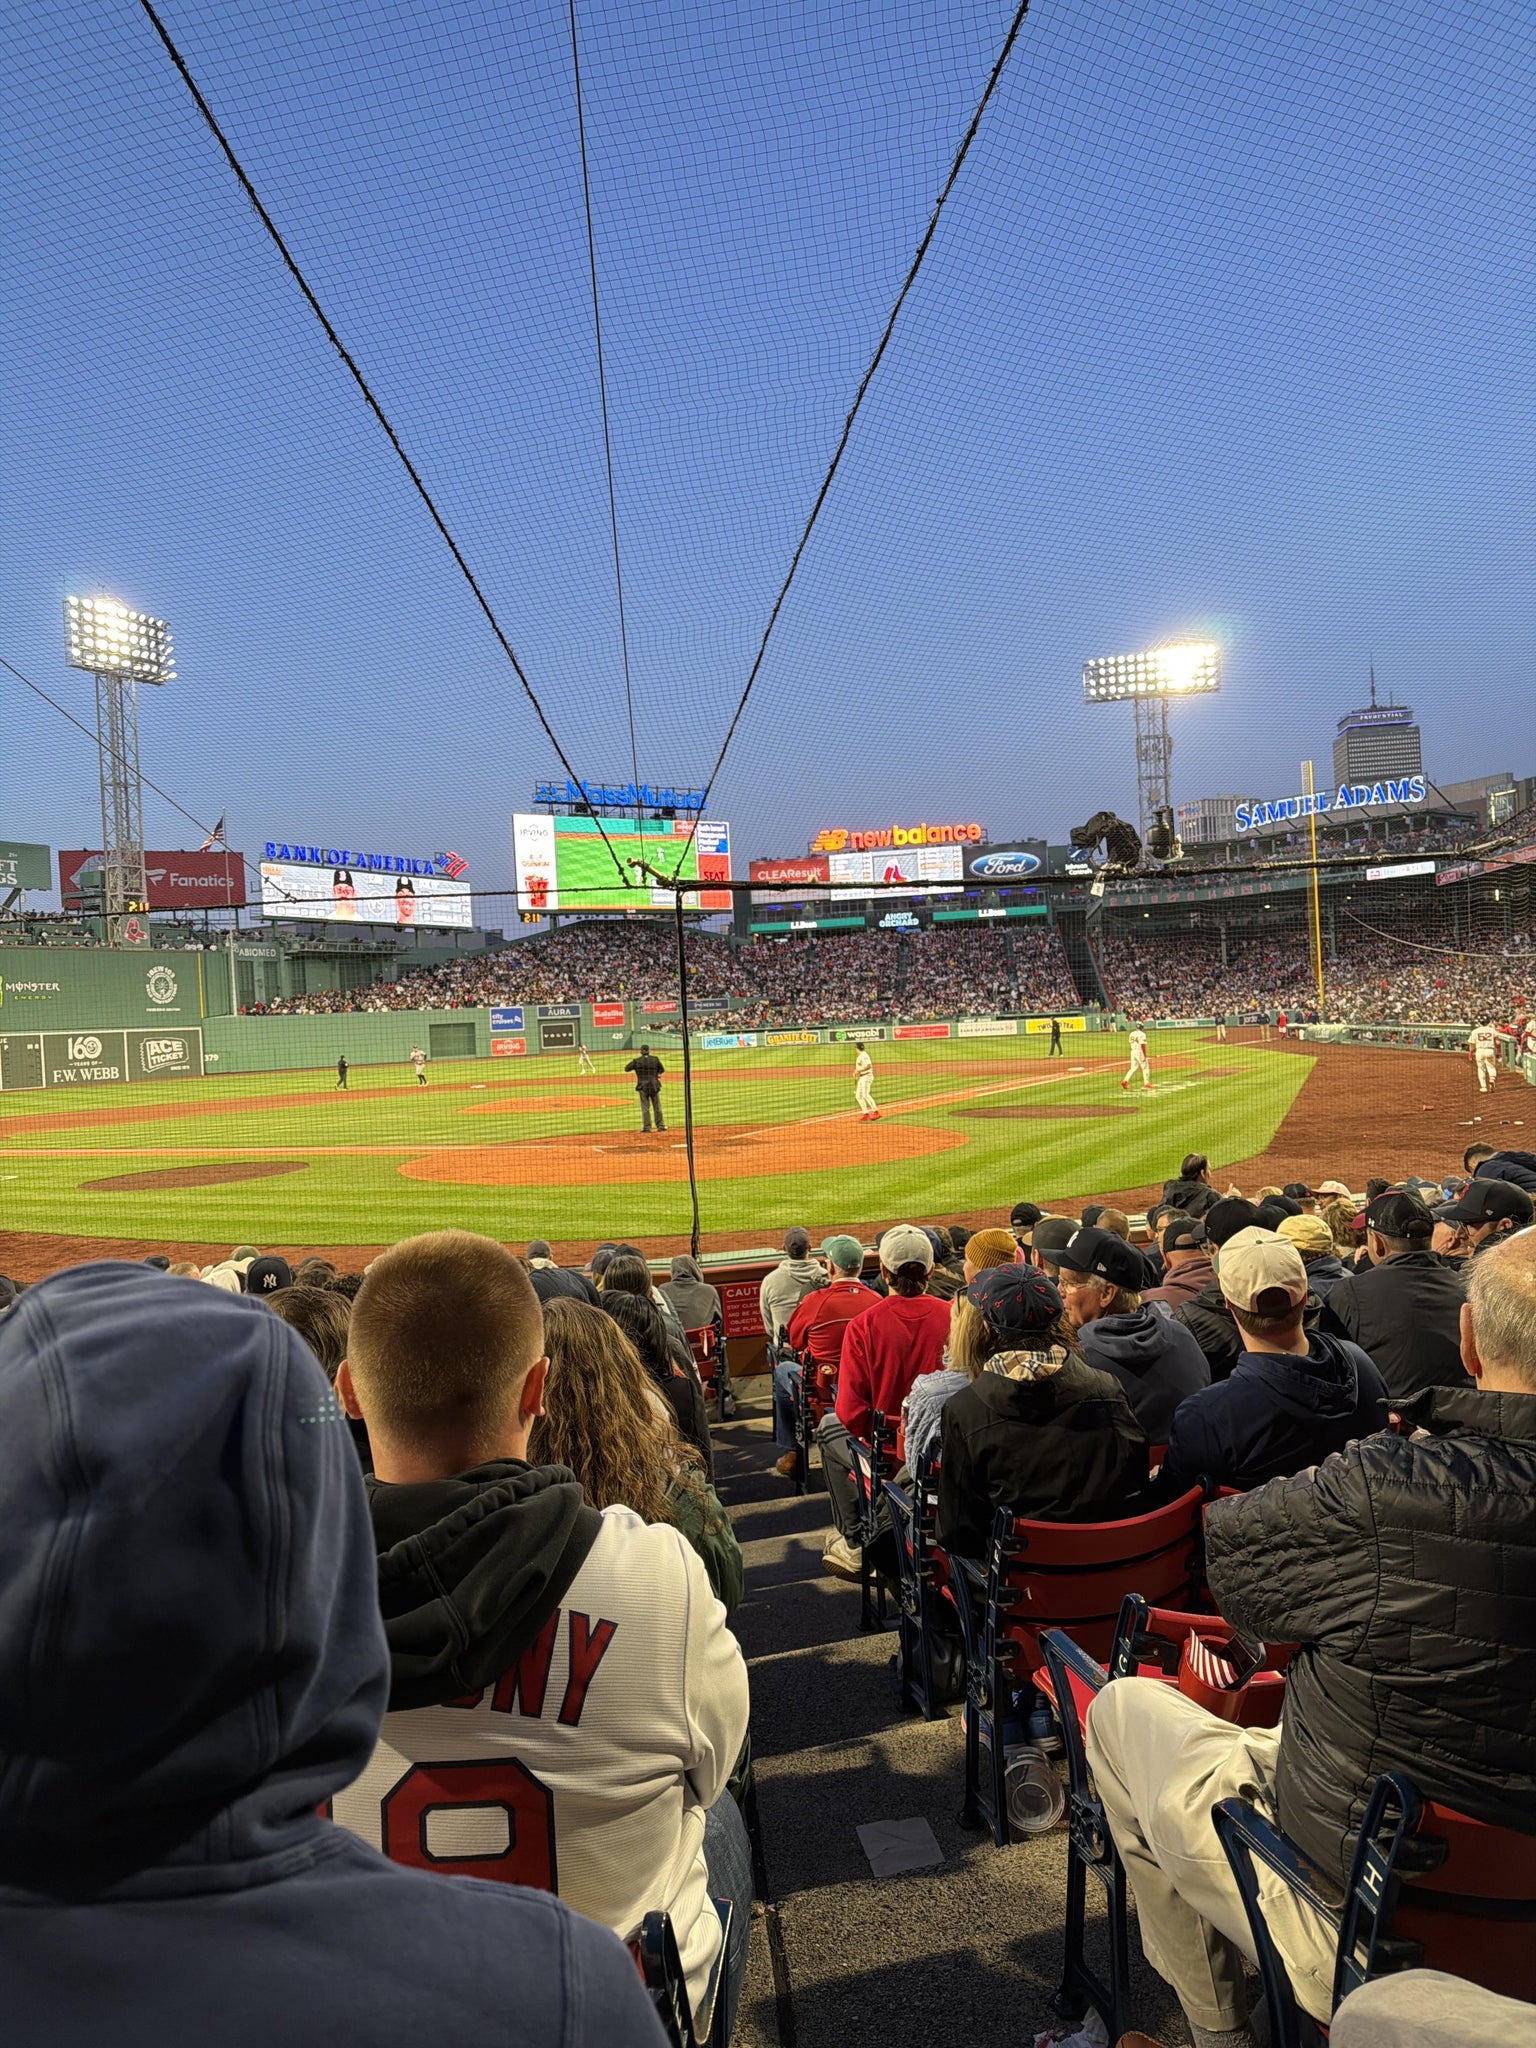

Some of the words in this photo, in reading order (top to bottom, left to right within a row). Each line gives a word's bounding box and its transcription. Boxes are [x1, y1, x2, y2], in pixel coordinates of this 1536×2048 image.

[565, 778, 707, 810] MassMutual
[1235, 791, 1331, 833] SAMUEL
[1333, 775, 1427, 811] ADAMS
[265, 840, 322, 864] BANK
[327, 848, 351, 866] OF
[356, 851, 435, 876] AMERICA
[983, 856, 1027, 875] Ford
[169, 872, 235, 888] Fanatics
[757, 866, 821, 881] CLEAResult
[879, 917, 920, 928] ORCHARD
[885, 912, 913, 921] ANGRY
[239, 948, 277, 957] ABIOMED
[547, 1008, 572, 1016] AURA
[767, 1032, 800, 1044] GRANITE
[800, 1031, 818, 1044] CITY
[847, 1028, 880, 1038] wasabi
[1477, 1032, 1493, 1042] 52
[149, 1039, 184, 1055] ACE
[496, 1043, 521, 1051] IRVING
[706, 1036, 734, 1047] jetBlue
[150, 1052, 184, 1065] TICKET
[80, 1066, 120, 1082] WEBB
[726, 1286, 759, 1298] CAUT
[730, 1317, 758, 1325] OBJECTS
[1362, 1861, 1384, 1897] H
